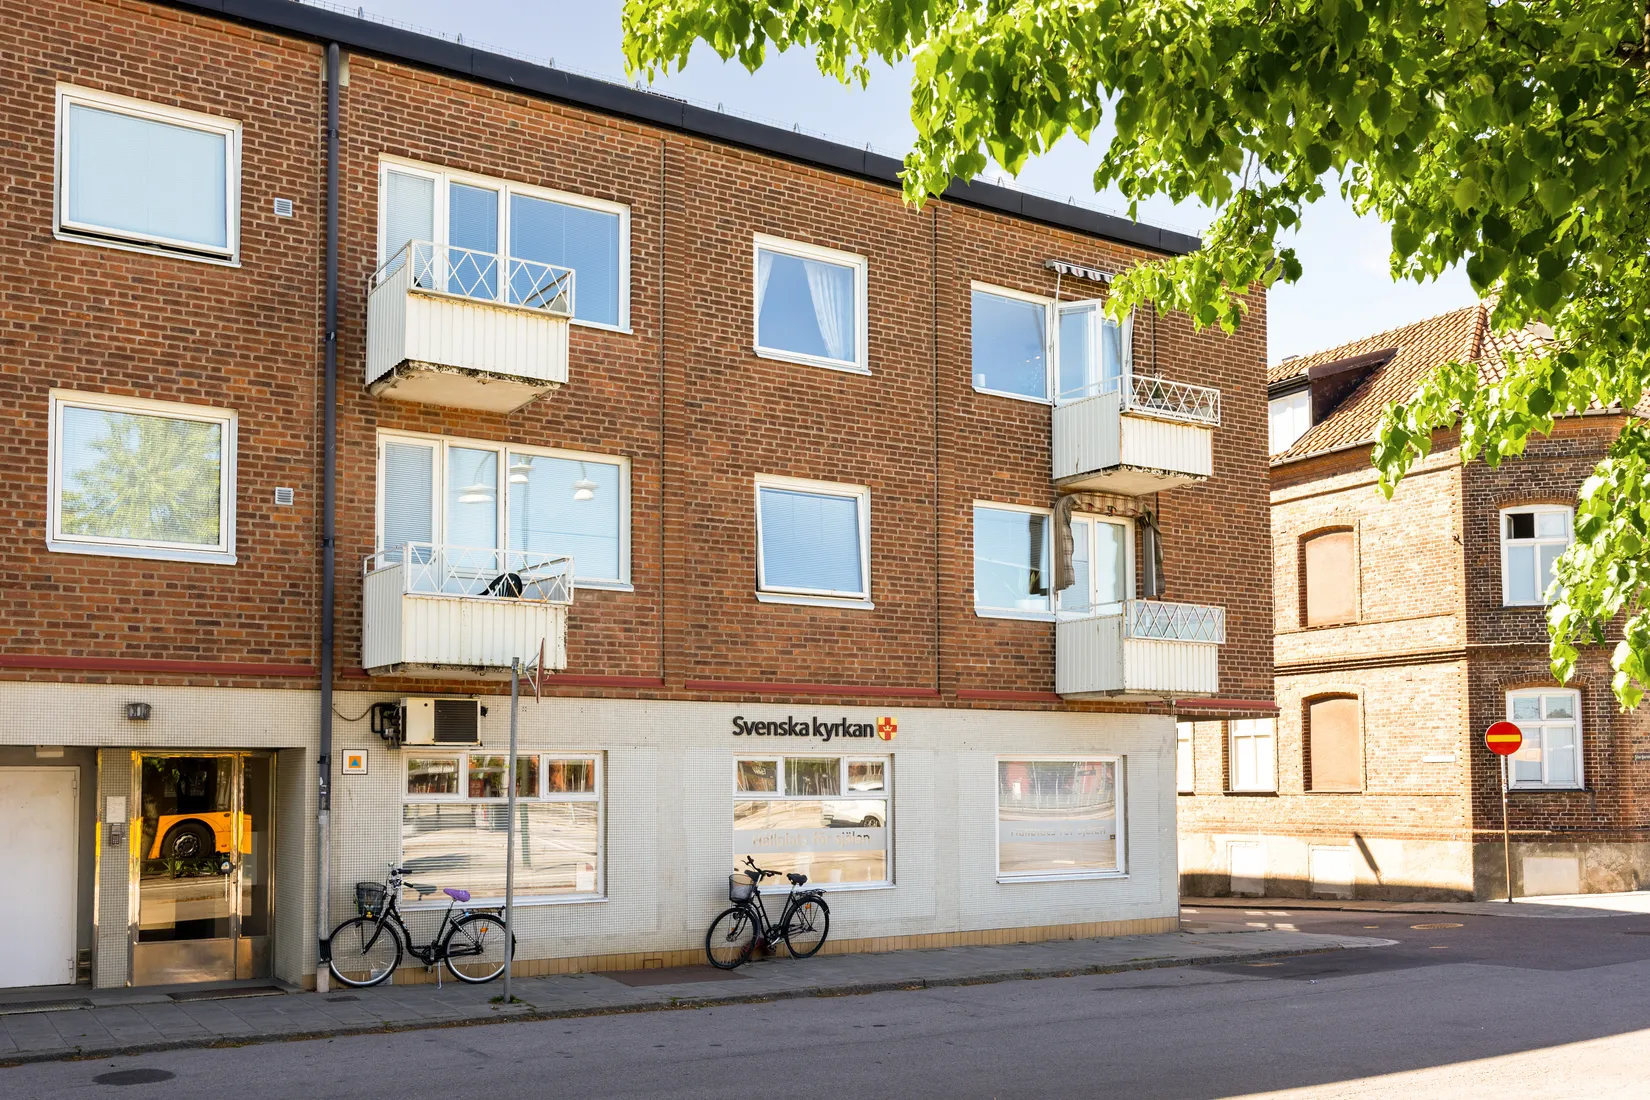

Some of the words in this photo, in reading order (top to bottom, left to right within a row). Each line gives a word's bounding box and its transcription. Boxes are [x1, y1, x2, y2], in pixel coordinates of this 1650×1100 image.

[732, 715, 810, 737] Svenska
[812, 716, 875, 742] kyrkan
[835, 831, 872, 847] själen
